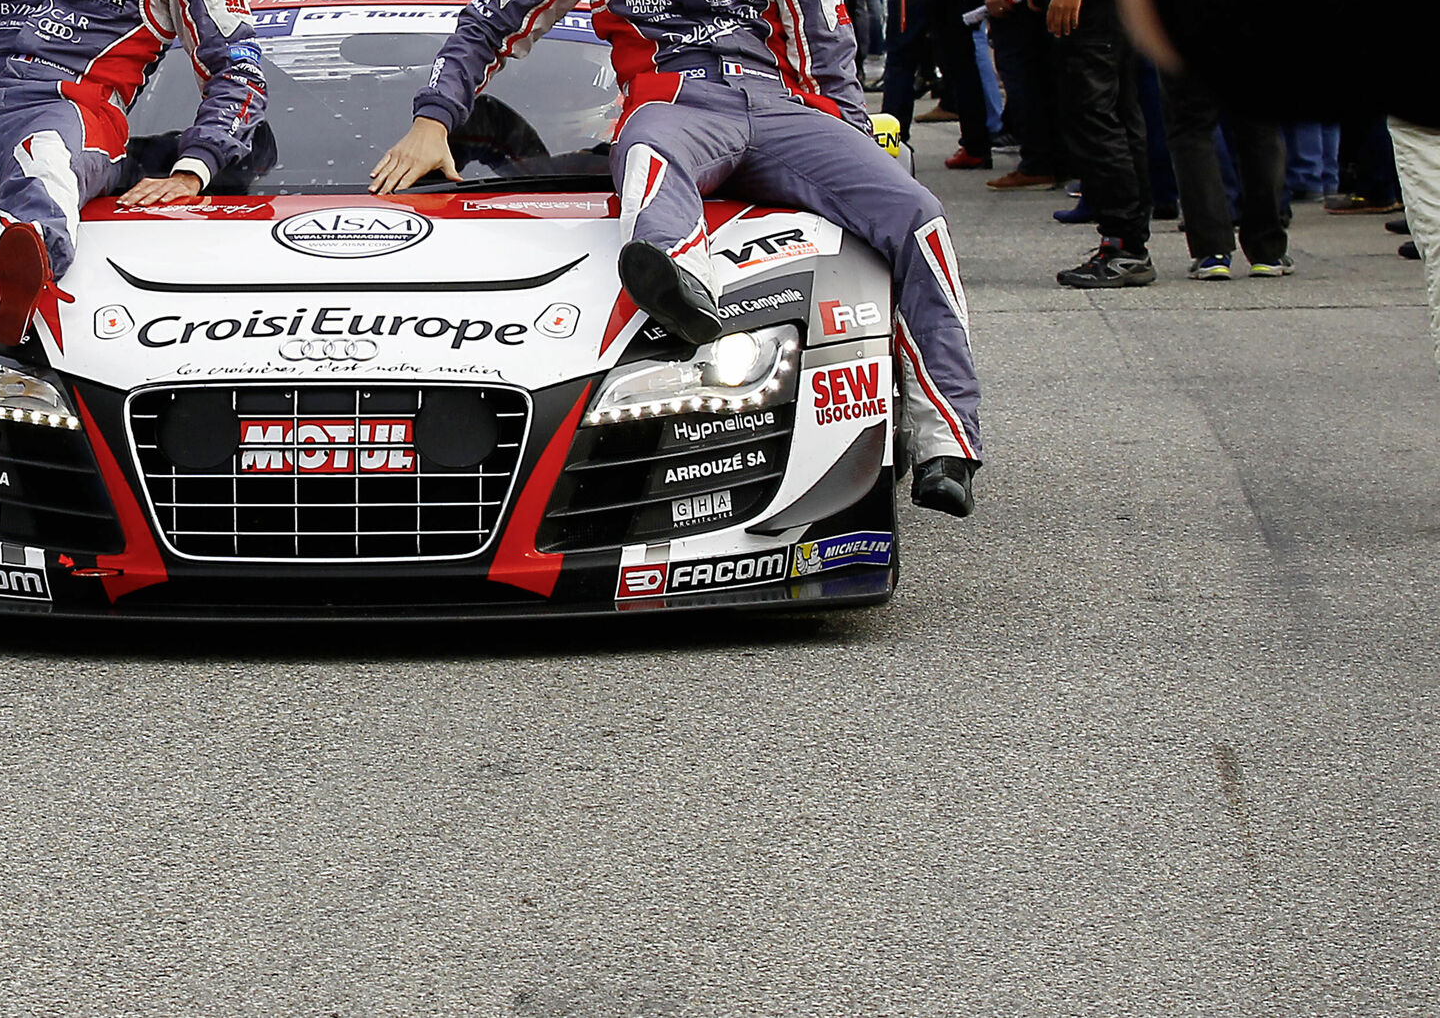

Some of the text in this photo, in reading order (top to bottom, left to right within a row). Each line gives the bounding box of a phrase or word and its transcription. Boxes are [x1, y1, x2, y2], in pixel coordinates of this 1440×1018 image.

[293, 214, 413, 232] AISM
[710, 228, 809, 265] VTR
[781, 242, 814, 251] TOUR
[137, 307, 528, 350] CroisiEurope
[832, 301, 882, 327] R8
[812, 362, 879, 409] SEW
[673, 411, 775, 441] Hypnelique
[815, 398, 887, 426] USOCOME
[241, 424, 414, 469] MOTUL
[664, 450, 767, 484] ARROUZÉ SA
[824, 540, 891, 559] MICHELIN
[671, 552, 785, 588] FACOM
